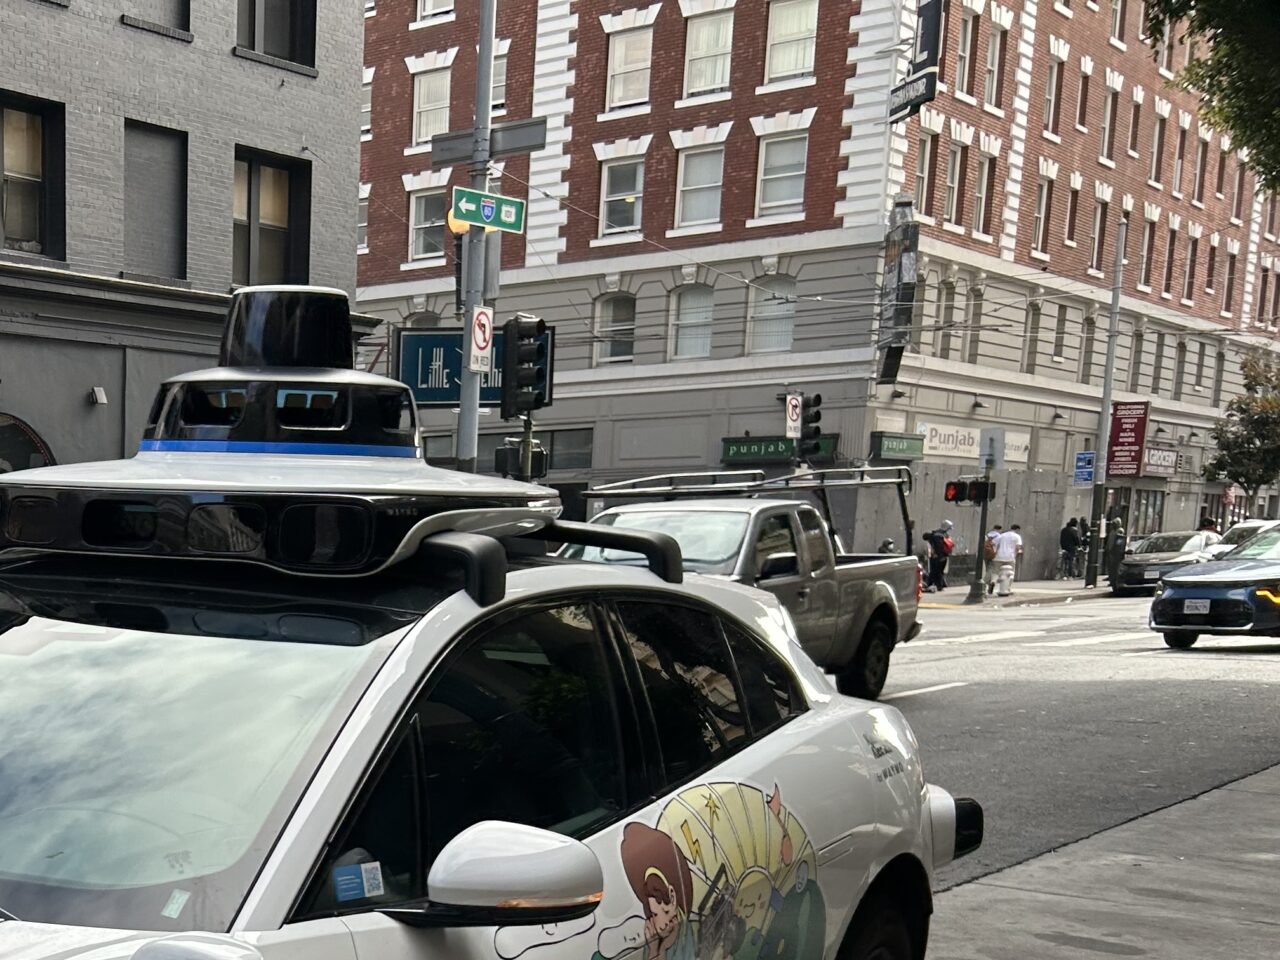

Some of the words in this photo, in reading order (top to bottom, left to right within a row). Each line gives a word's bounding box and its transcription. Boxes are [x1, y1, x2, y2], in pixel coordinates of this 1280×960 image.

[484, 206, 491, 216] 80
[417, 347, 450, 388] Little
[480, 356, 489, 367] RED
[884, 440, 907, 452] punjab
[929, 428, 975, 449] Punjab
[729, 441, 785, 456] punjab
[1150, 449, 1176, 466] GROCERY
[882, 762, 904, 780] WAYMO
